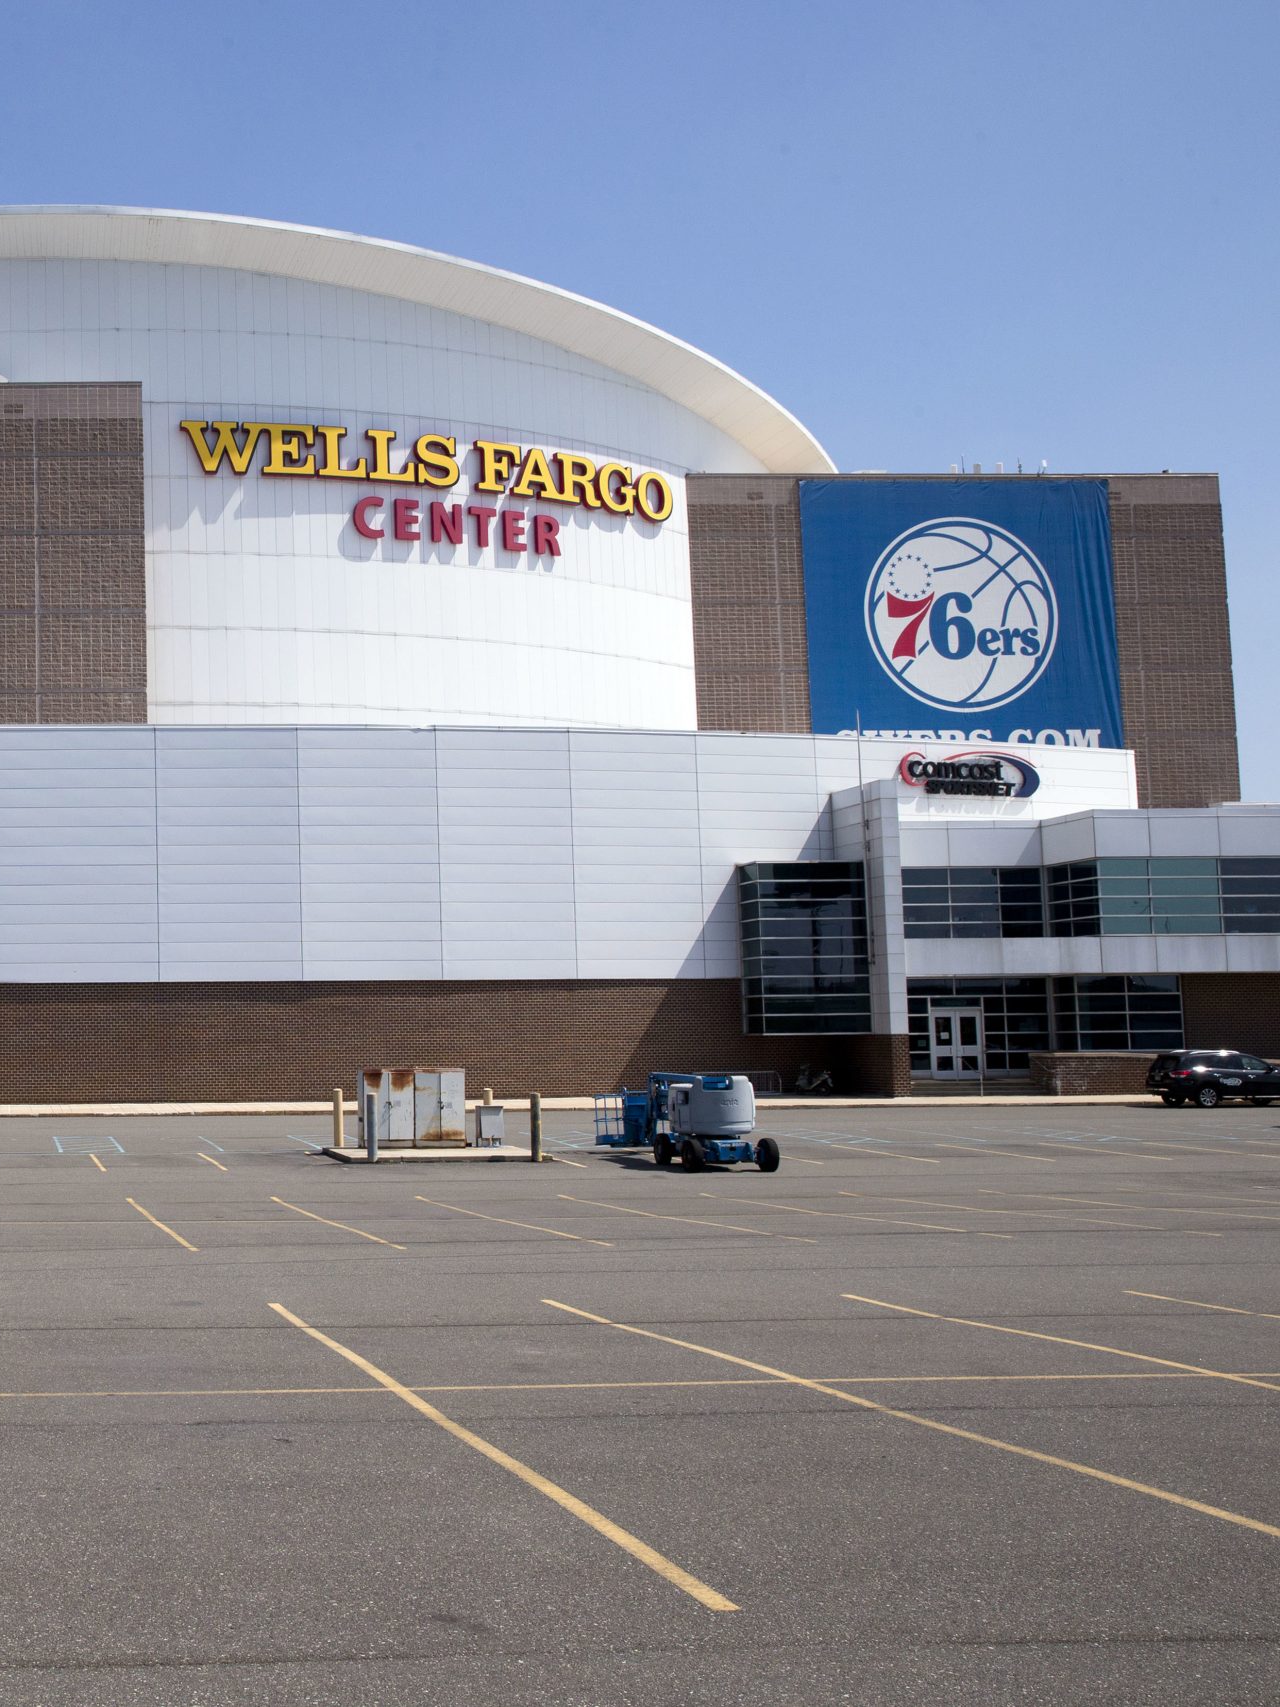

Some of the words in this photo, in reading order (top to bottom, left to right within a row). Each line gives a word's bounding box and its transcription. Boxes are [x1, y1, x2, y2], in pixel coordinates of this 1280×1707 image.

[180, 420, 460, 489] WELLS
[474, 440, 675, 523] FARGO
[353, 496, 561, 557] CENTER
[886, 590, 1041, 661] 76ers
